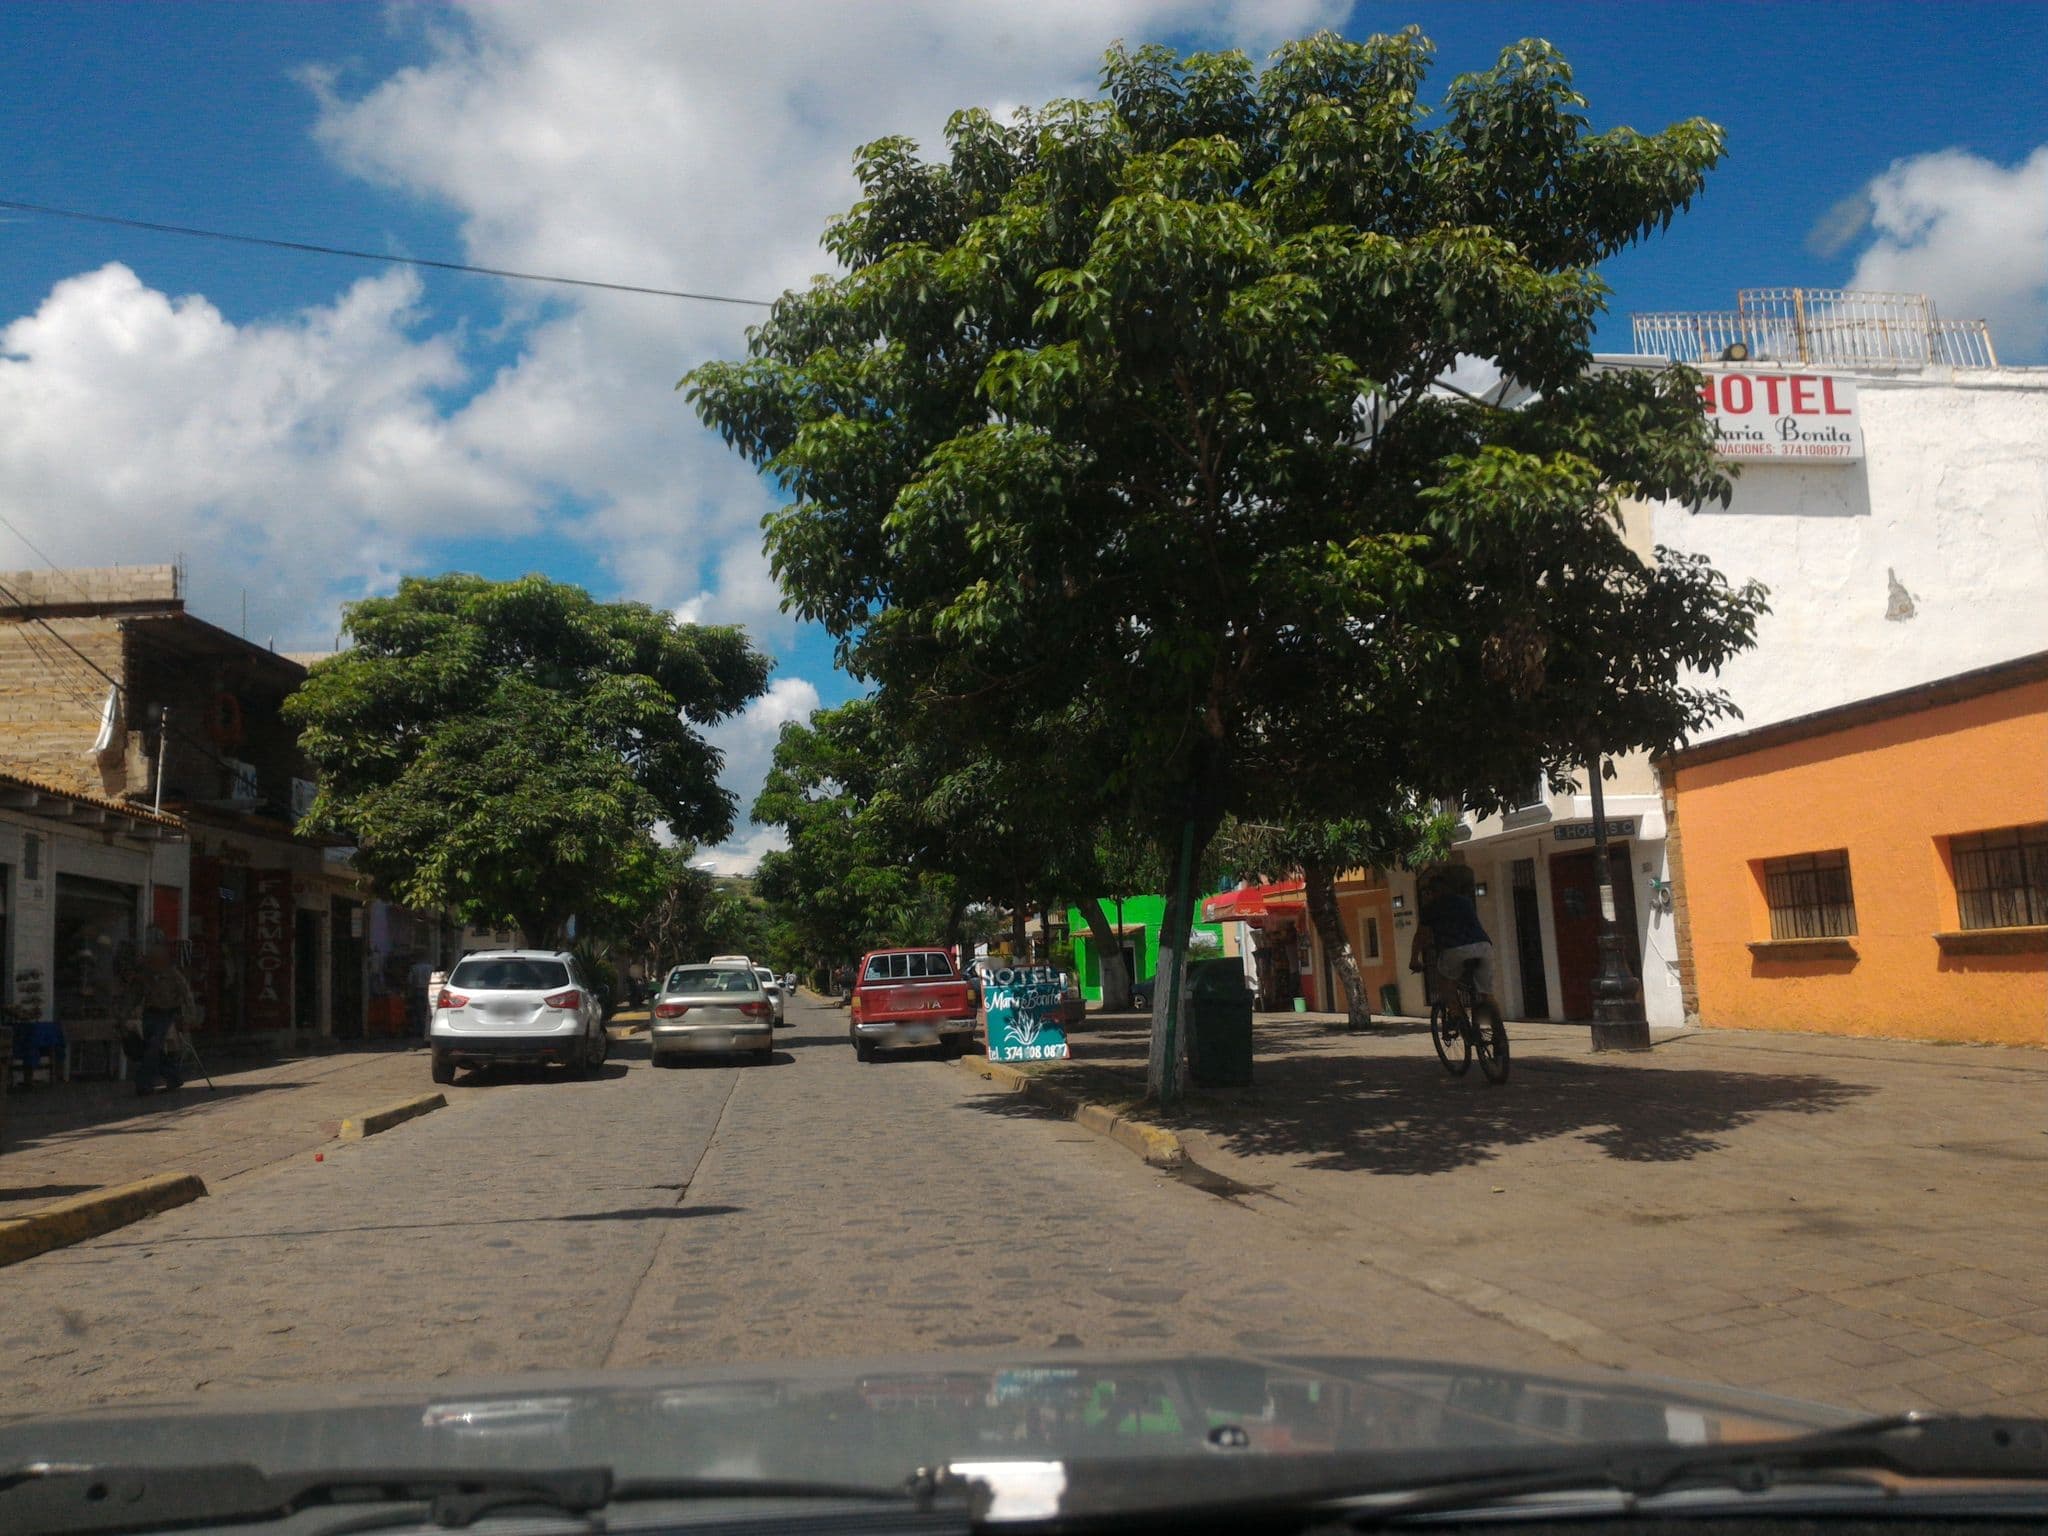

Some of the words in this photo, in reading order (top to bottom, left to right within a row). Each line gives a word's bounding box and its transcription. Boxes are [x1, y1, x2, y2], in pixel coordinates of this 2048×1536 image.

[1775, 416, 1852, 442] Bonita
[257, 879, 281, 1001] FARMACIA
[981, 965, 1059, 987] HOTEL
[1004, 1046, 1023, 1060] 374
